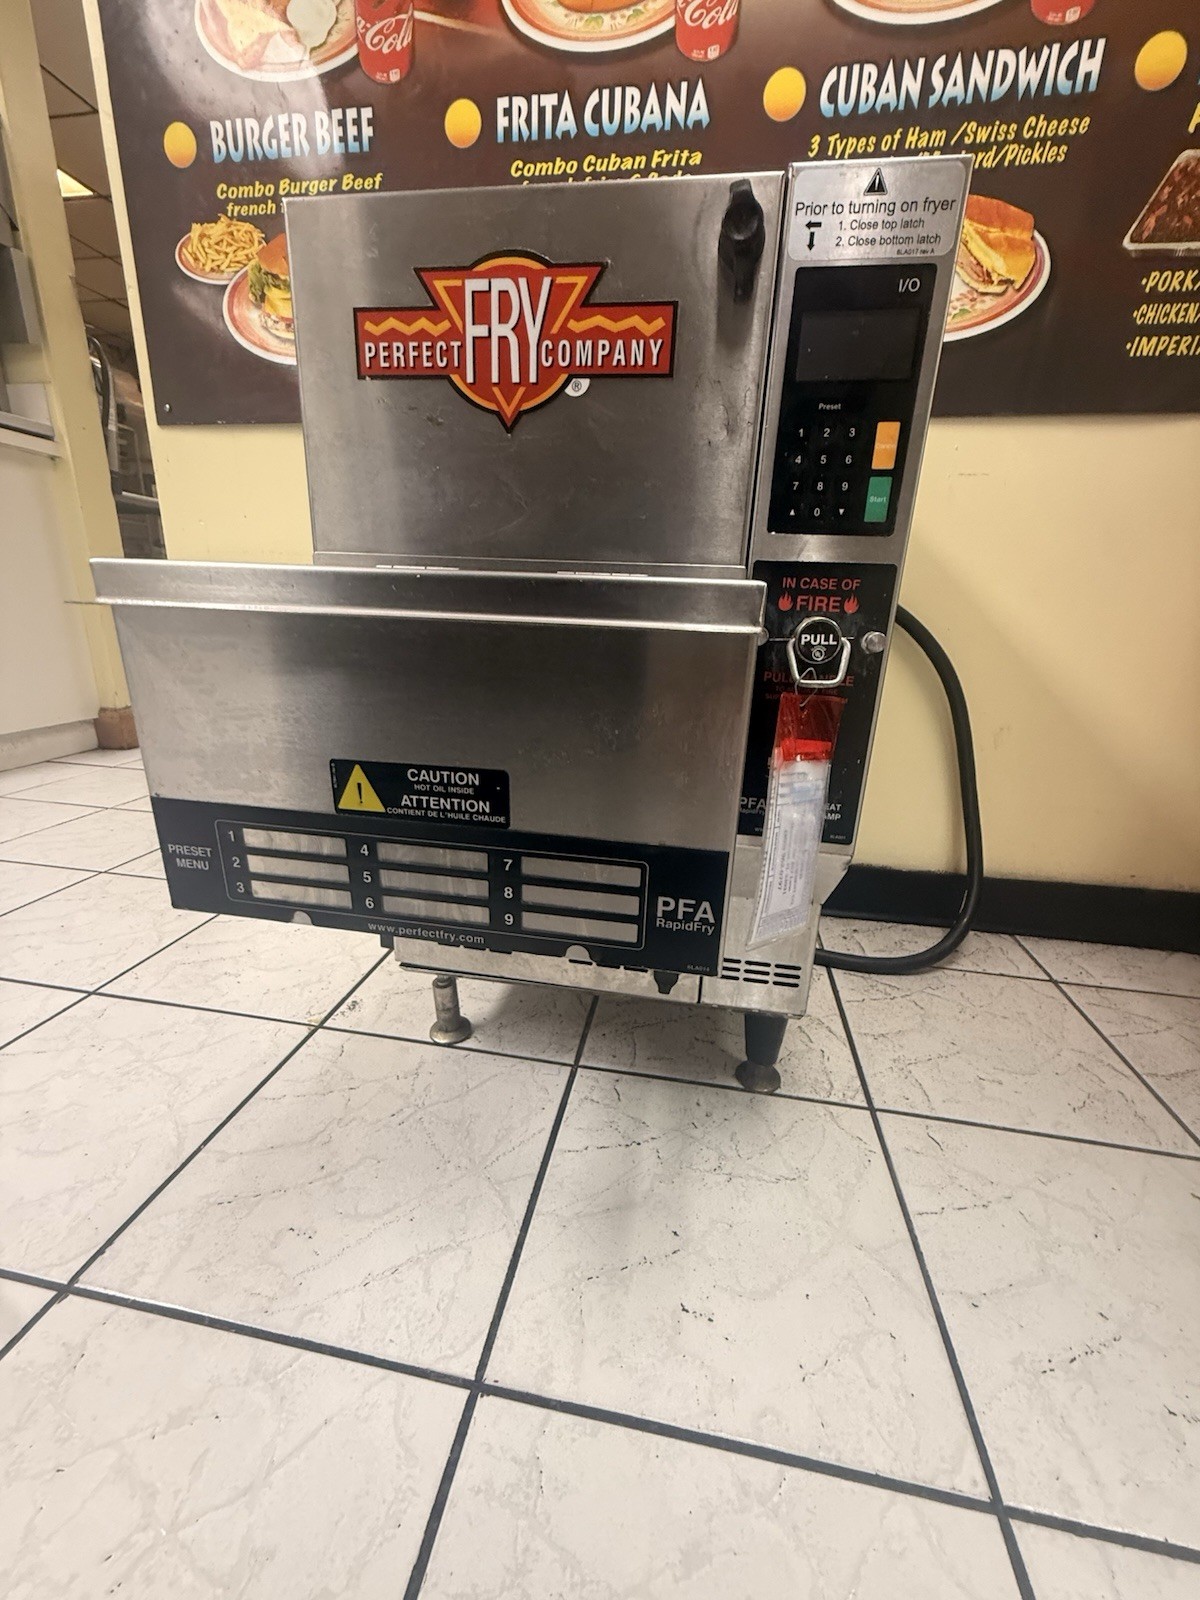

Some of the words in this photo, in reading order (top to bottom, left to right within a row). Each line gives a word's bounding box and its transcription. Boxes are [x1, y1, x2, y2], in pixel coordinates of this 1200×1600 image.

[819, 56, 926, 118] CUBAN
[928, 38, 1107, 107] SANDWICH
[496, 90, 578, 143] FRITA
[584, 77, 710, 137] CUBANA
[209, 112, 309, 164] BURGER
[315, 106, 375, 155] BEEF
[808, 134, 820, 158] 3
[827, 133, 876, 159] Types
[881, 128, 903, 151] of
[905, 126, 946, 149] Ham
[1022, 114, 1090, 139] Cheese
[510, 157, 578, 177] Combo
[583, 153, 647, 173] Cuban
[651, 150, 702, 168] Frita
[216, 181, 275, 199] Combo
[279, 178, 338, 196] Burger
[342, 173, 383, 190] Beef
[226, 200, 276, 217] french
[795, 202, 828, 216] Prior
[832, 202, 844, 214] to
[848, 199, 896, 216] turning
[901, 201, 918, 213] on
[923, 197, 956, 215] fryer
[838, 221, 847, 231] 1.
[850, 219, 878, 230] Close
[881, 219, 897, 231] top
[900, 218, 925, 229] latch
[835, 237, 845, 247] 2.
[847, 235, 876, 246] Close
[879, 235, 914, 246] bottom
[916, 234, 941, 245] latch
[898, 278, 921, 293] I/O
[364, 340, 462, 368] PERFECT
[464, 276, 552, 384] FRY
[541, 338, 663, 367] COMPANY
[798, 428, 804, 437] 1
[823, 428, 830, 437] 2
[849, 428, 856, 437] 3
[795, 455, 802, 464] 4
[820, 455, 827, 464] 5
[845, 455, 852, 464] 6
[793, 482, 799, 490] 7
[817, 482, 823, 491] 8
[842, 482, 849, 491] 9
[813, 508, 820, 516] 0
[782, 577, 796, 589] IN
[800, 578, 836, 590] CASE
[841, 579, 861, 590] OF
[796, 595, 841, 612] FIRE
[801, 634, 837, 645] PULL
[407, 768, 480, 786] CAUTION
[414, 784, 431, 792] HOT
[432, 785, 446, 793] OIL
[448, 786, 475, 795] INSIDE
[401, 795, 490, 813] ATTENTION
[386, 806, 426, 817] CONTIENT
[427, 809, 438, 818] DE
[439, 811, 471, 821] L'HUILE
[472, 814, 506, 824] CHAUDE
[228, 830, 235, 842] 1
[168, 844, 212, 858] PRESET
[360, 844, 369, 856] 4
[176, 857, 209, 871] MENU
[233, 857, 241, 868] 2
[503, 859, 513, 871] 7
[363, 871, 372, 883] 5
[236, 882, 245, 893] 3
[503, 887, 514, 899] 8
[365, 897, 375, 909] 6
[656, 896, 715, 923] PFA
[504, 913, 514, 926] 9
[368, 922, 485, 944] www.perfectfry.com
[656, 918, 715, 936] RapidFry
